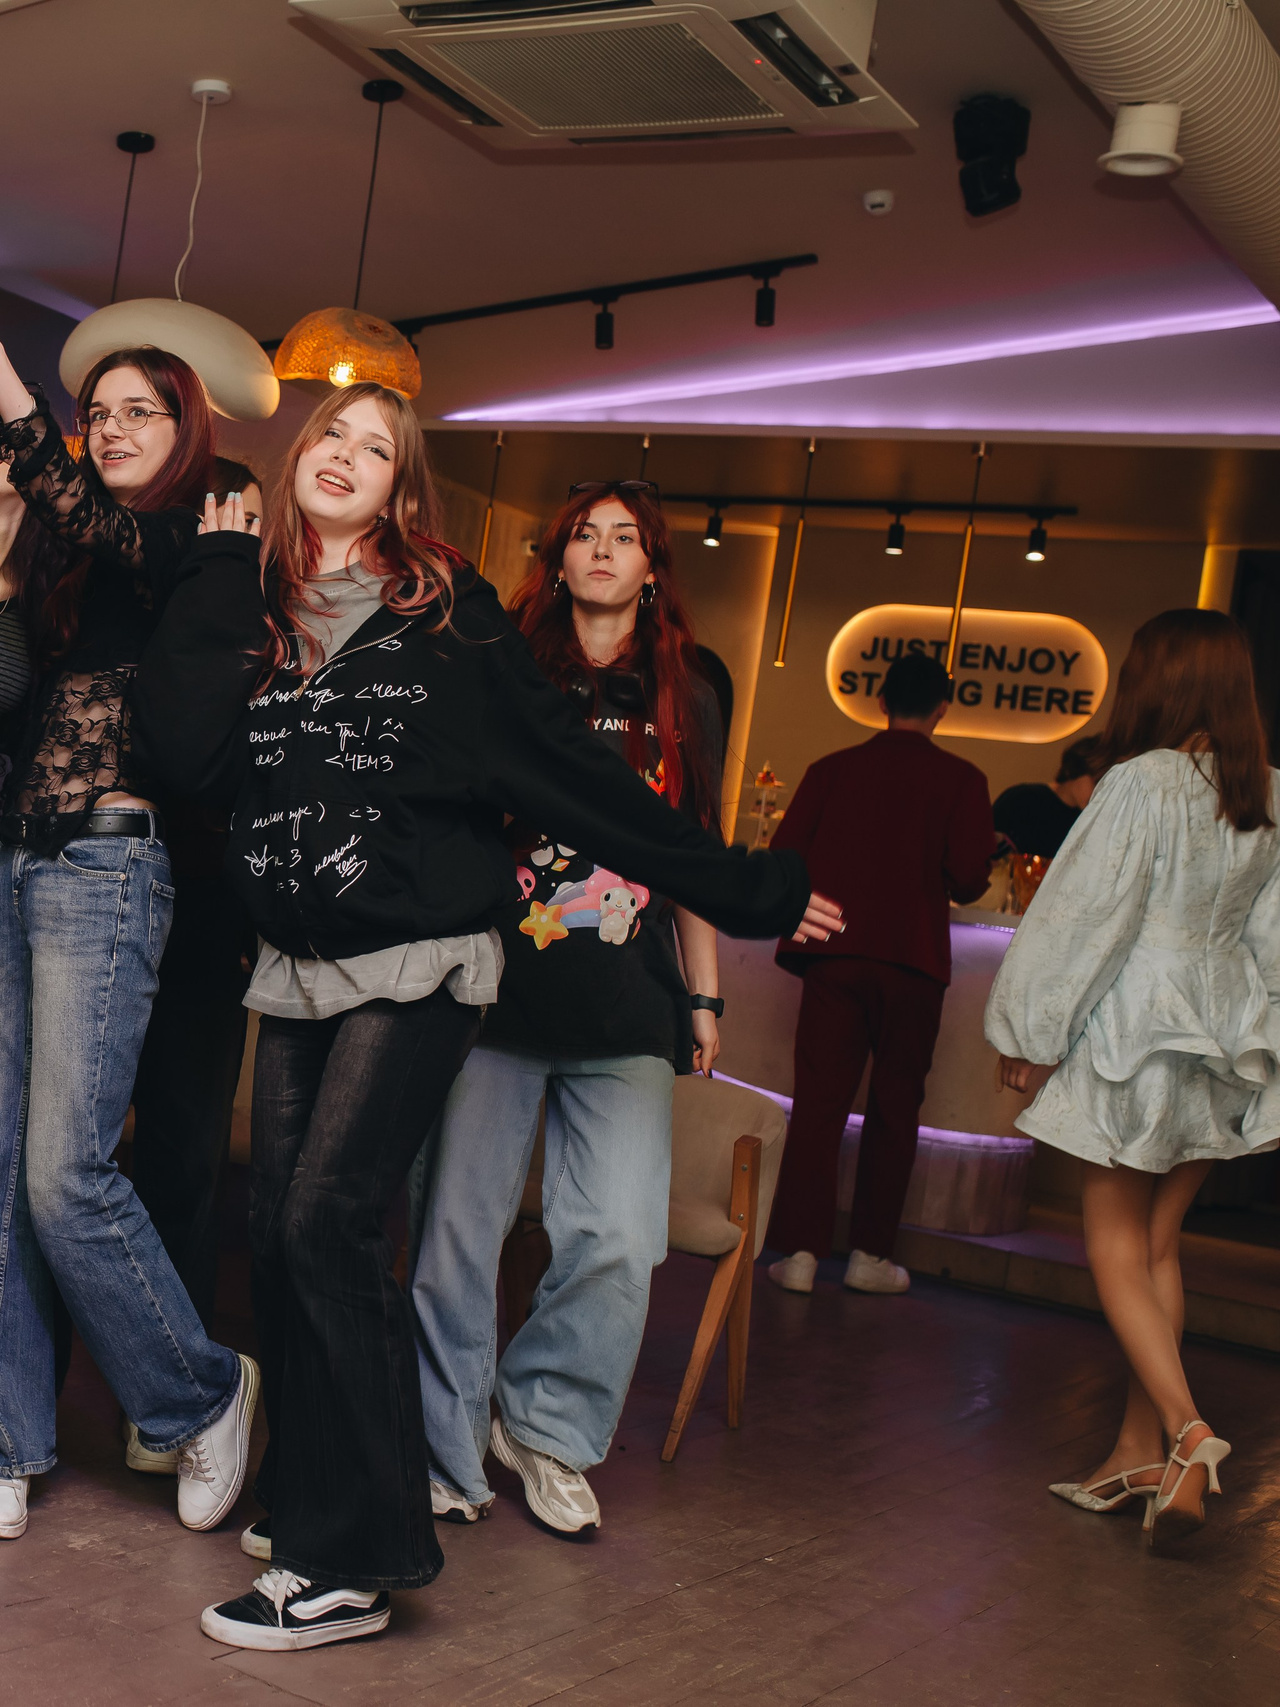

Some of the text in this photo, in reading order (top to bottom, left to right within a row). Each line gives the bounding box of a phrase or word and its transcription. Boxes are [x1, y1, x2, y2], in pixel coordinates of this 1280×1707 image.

[861, 637, 1080, 676] JUST ENJOY
[994, 683, 1094, 715] HERE
